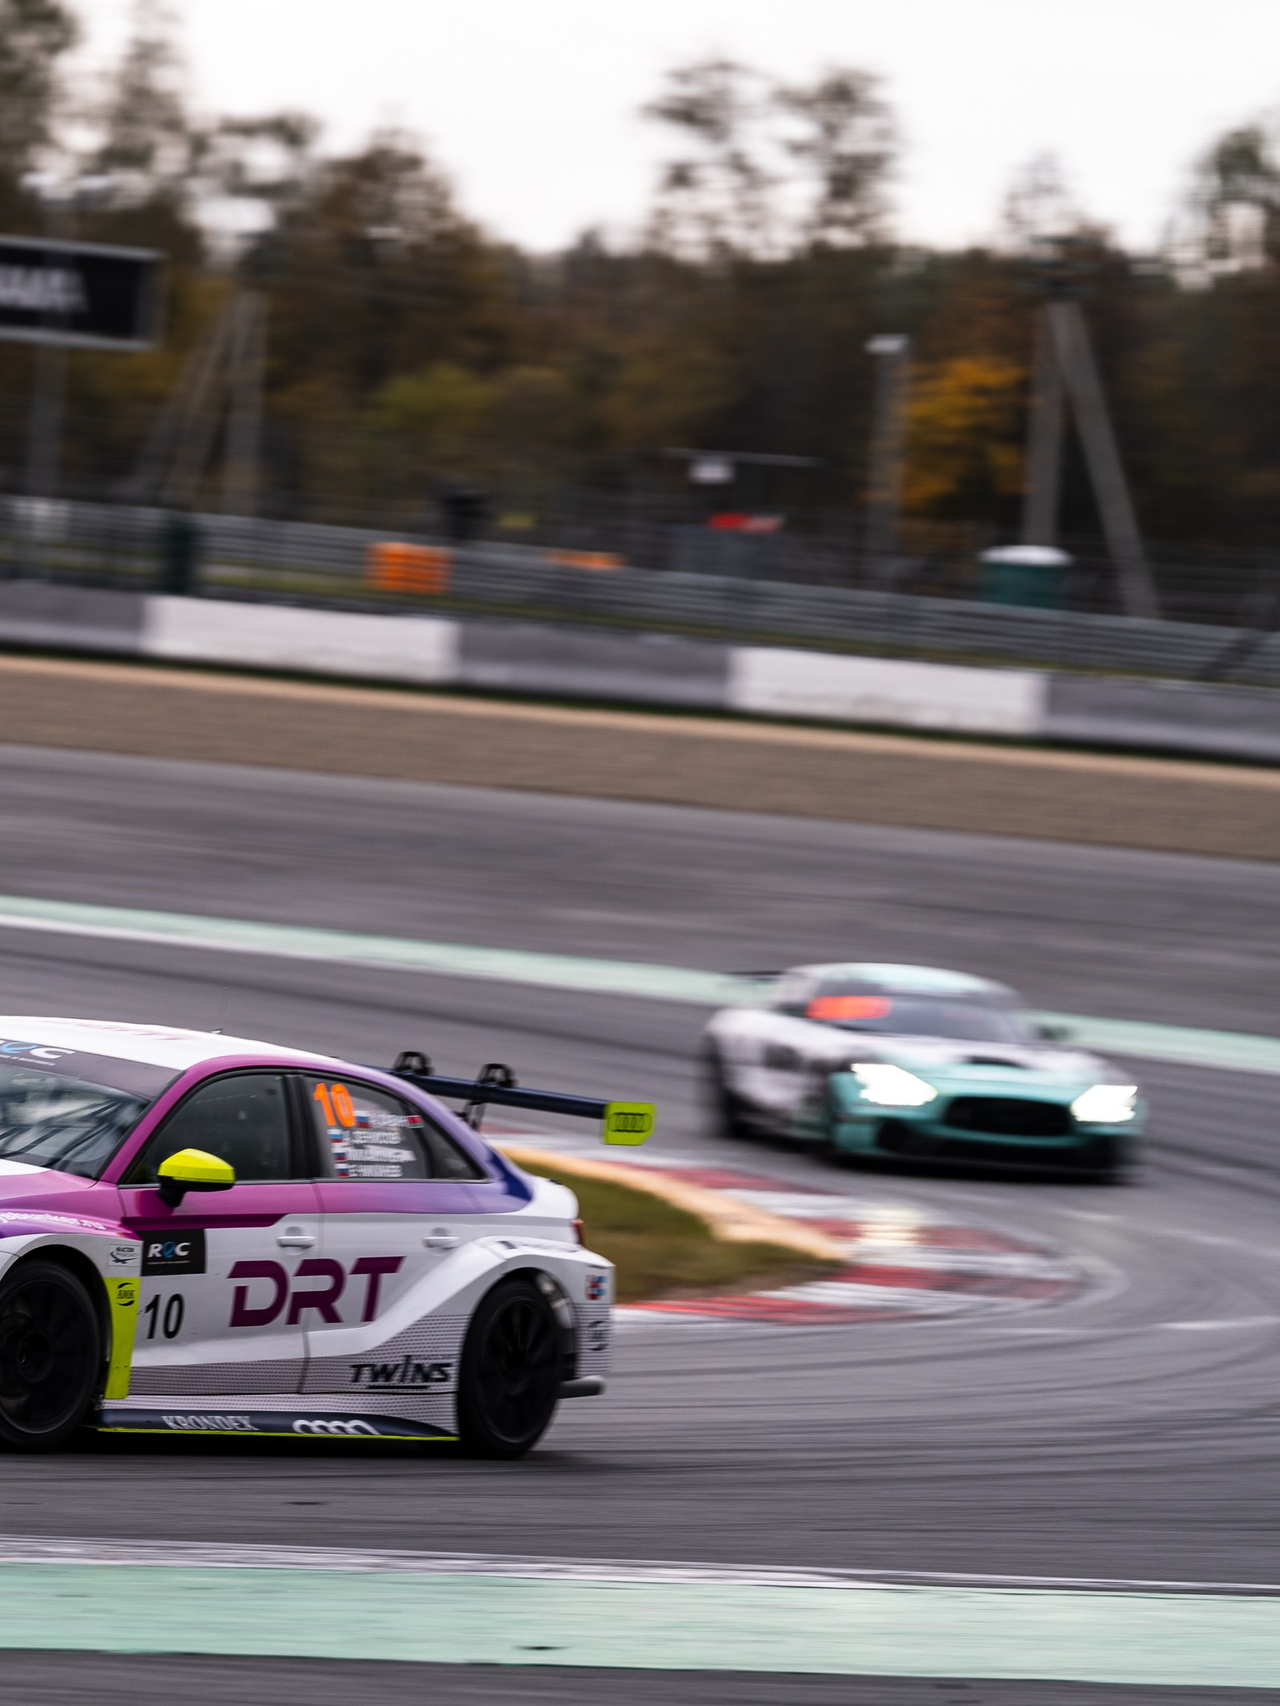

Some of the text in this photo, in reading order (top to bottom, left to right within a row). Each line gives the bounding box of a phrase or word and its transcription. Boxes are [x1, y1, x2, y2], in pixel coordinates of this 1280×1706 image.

[313, 1083, 356, 1127] 10
[226, 1256, 408, 1327] DRT
[144, 1293, 185, 1339] 10
[350, 1354, 452, 1384] TWINS
[161, 1415, 260, 1431] KRONDEX
